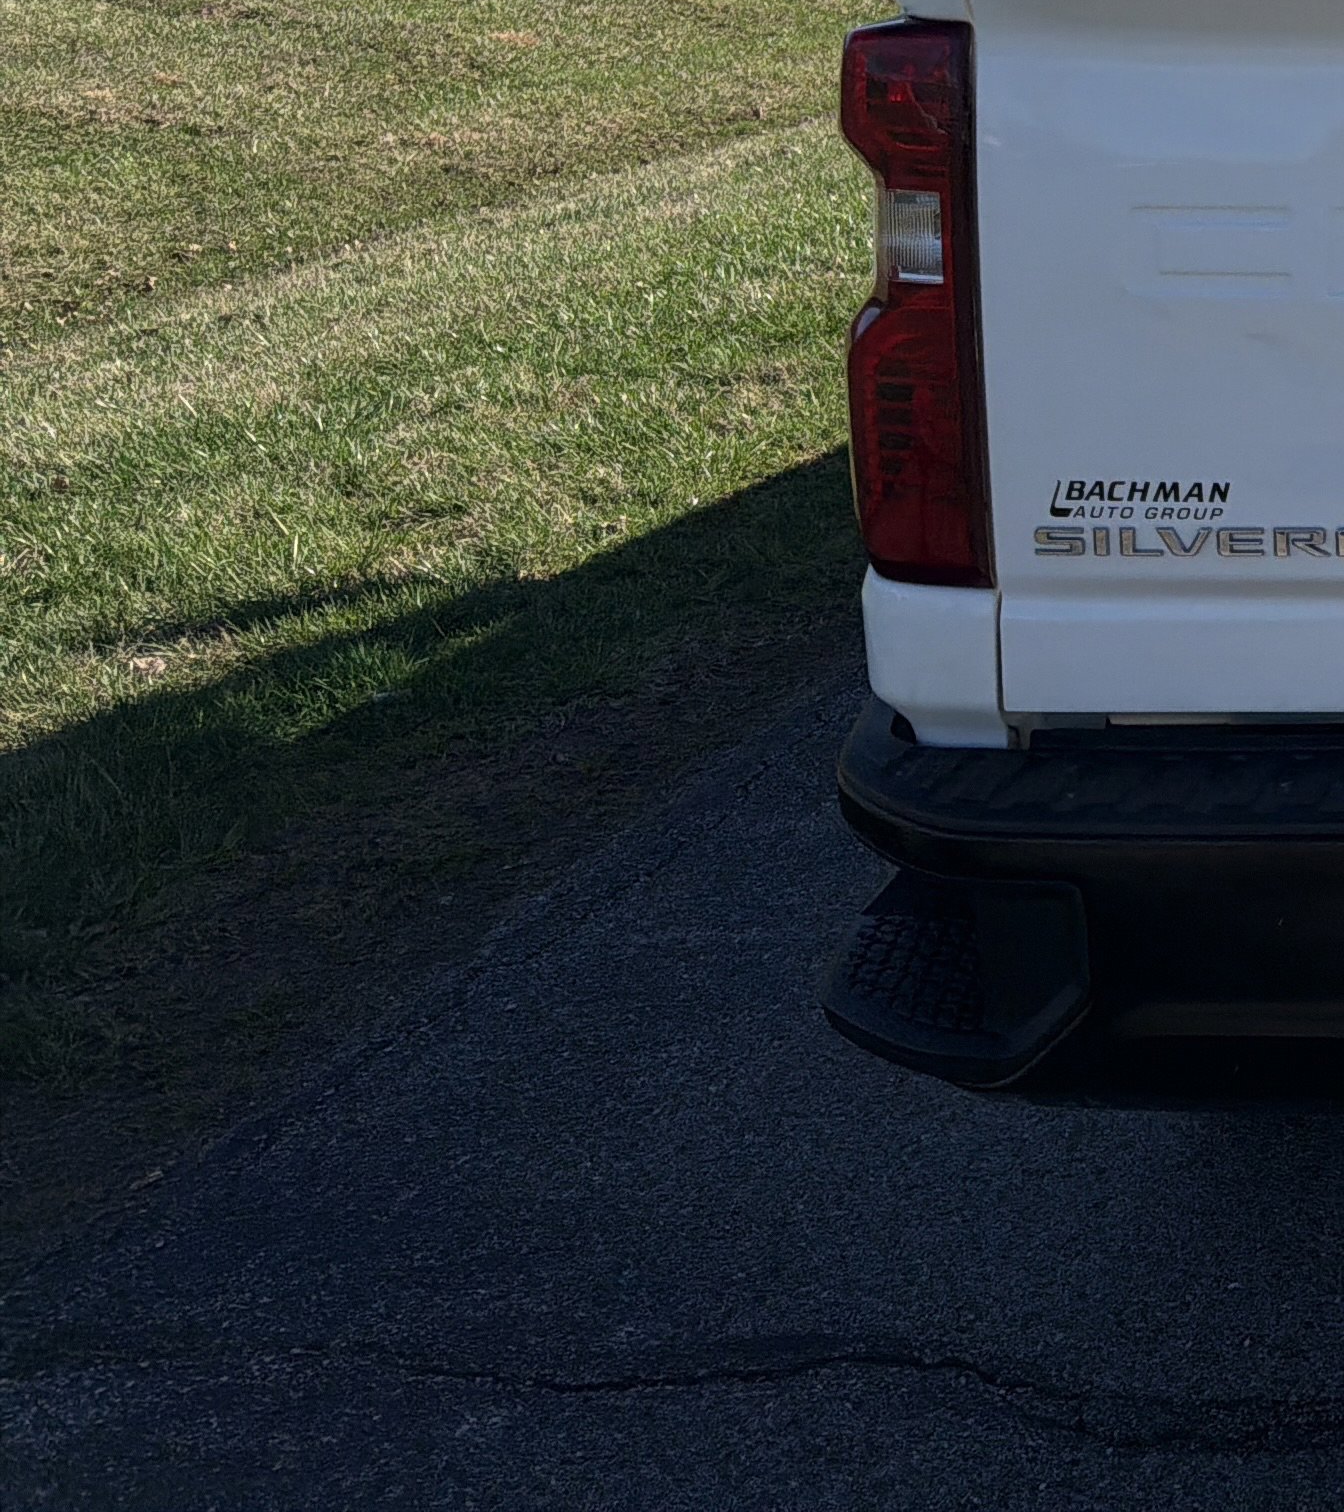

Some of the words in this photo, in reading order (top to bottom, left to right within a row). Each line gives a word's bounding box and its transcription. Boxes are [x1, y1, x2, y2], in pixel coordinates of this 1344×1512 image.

[1065, 481, 1231, 503] BACHMAN
[1073, 505, 1135, 520] AUTO
[1144, 507, 1224, 521] GROUP
